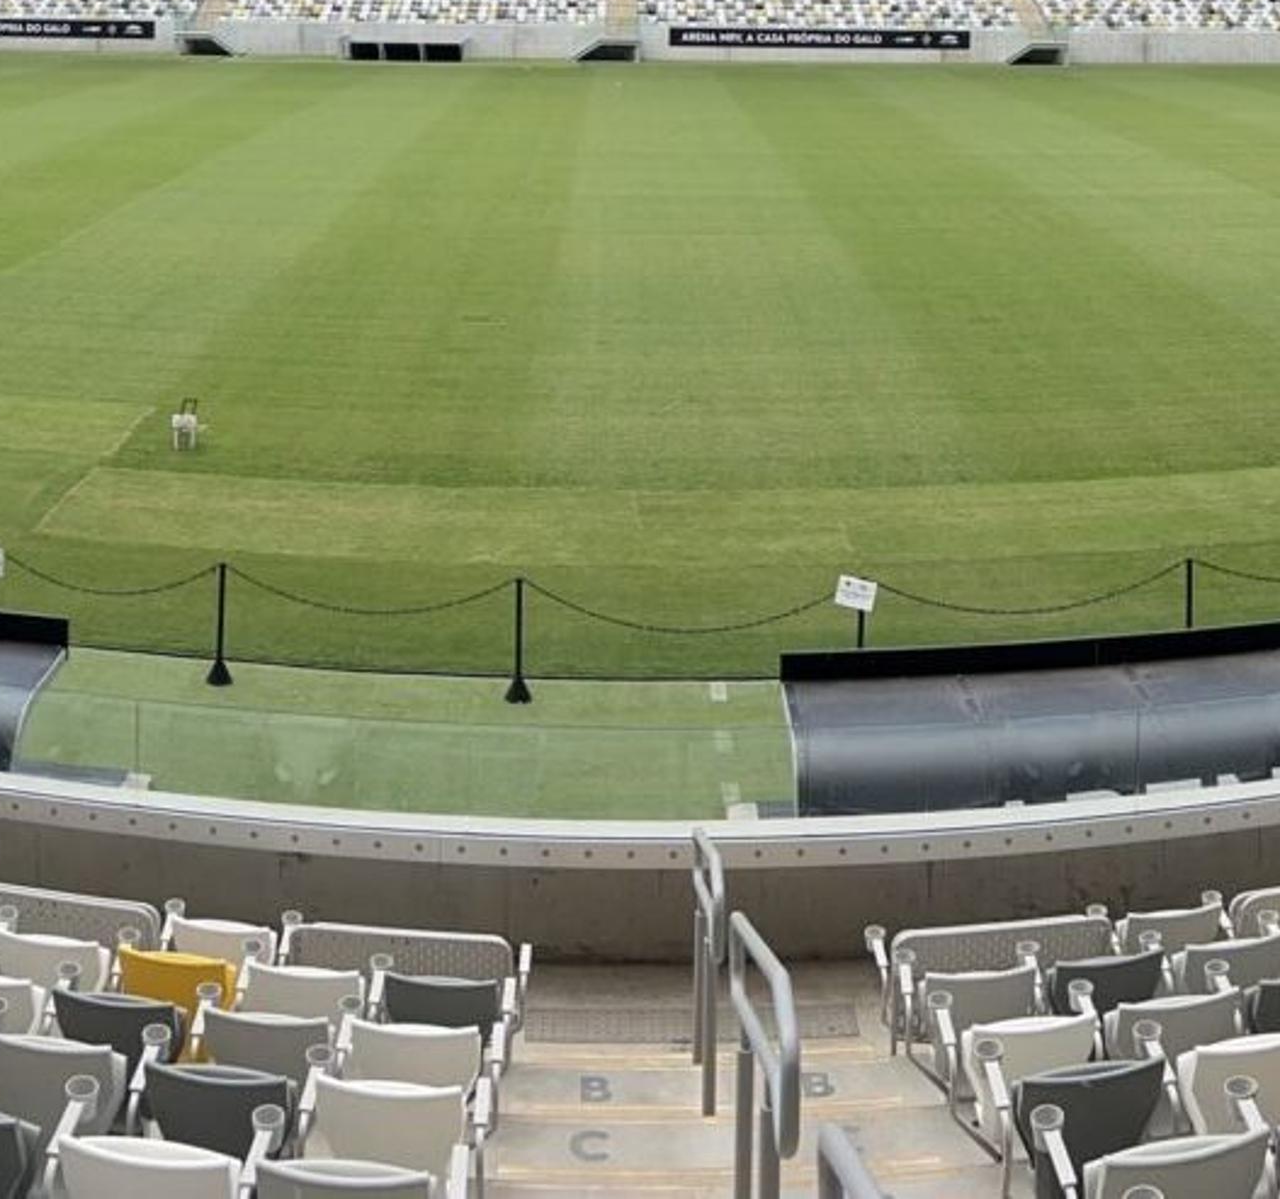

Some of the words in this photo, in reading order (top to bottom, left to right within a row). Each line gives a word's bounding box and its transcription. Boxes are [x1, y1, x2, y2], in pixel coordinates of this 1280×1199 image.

[26, 23, 42, 33] DO
[756, 32, 784, 43] CASA
[834, 33, 851, 44] DO
[581, 1075, 612, 1102] B
[569, 1130, 611, 1162] C
